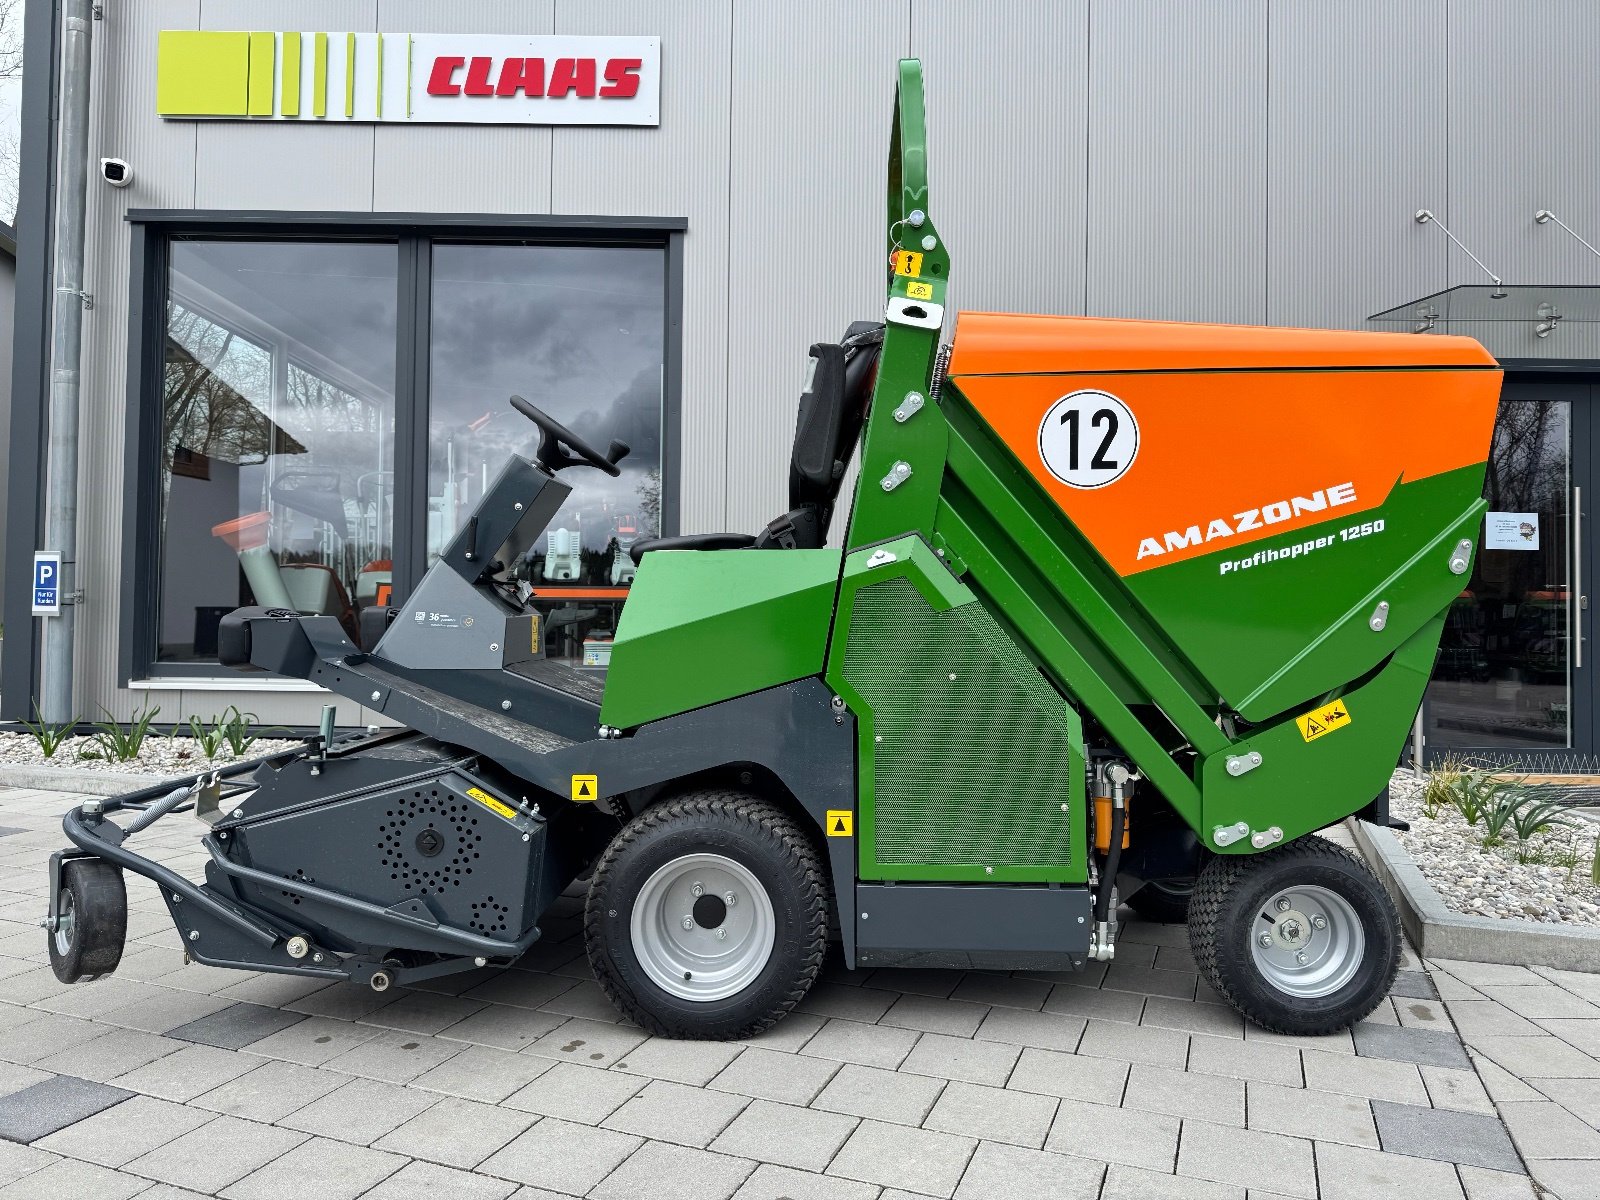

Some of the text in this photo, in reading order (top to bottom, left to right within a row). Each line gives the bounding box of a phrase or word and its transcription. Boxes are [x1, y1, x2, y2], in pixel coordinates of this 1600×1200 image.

[427, 56, 643, 97] CLAAS
[1060, 408, 1119, 471] 12
[1136, 481, 1358, 561] AMAZONE
[1219, 519, 1385, 576] Profihopper 1250
[40, 565, 53, 584] P
[428, 612, 440, 621] 36
